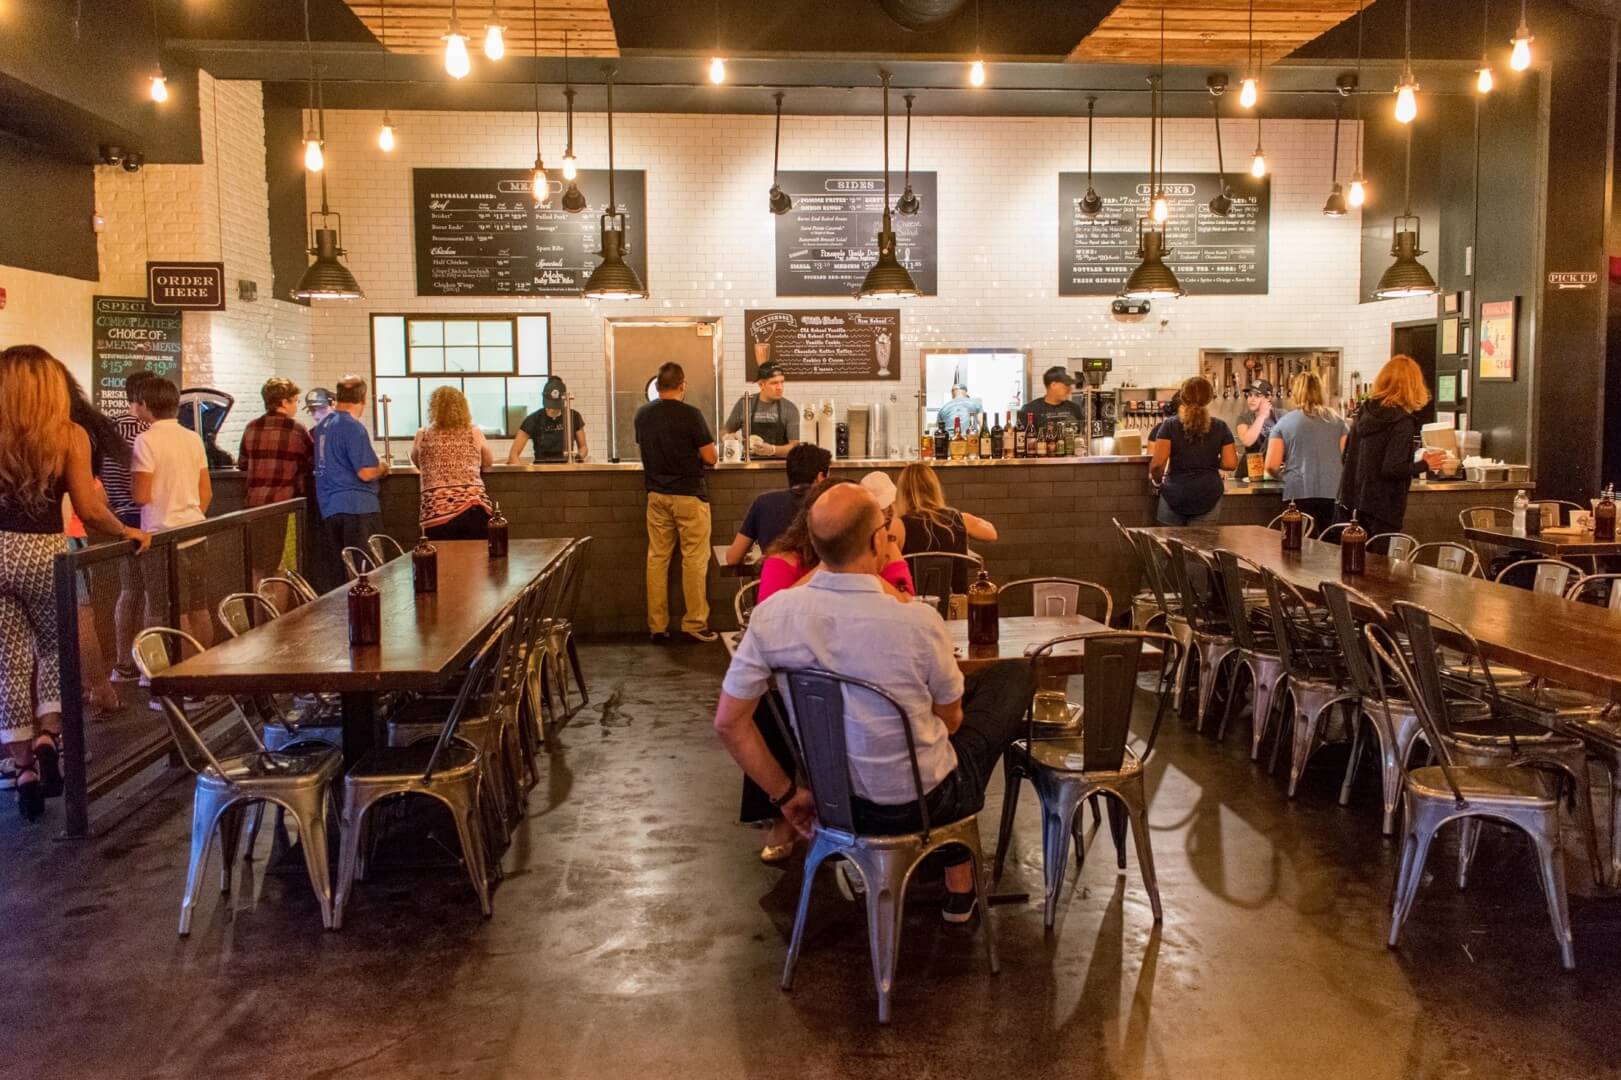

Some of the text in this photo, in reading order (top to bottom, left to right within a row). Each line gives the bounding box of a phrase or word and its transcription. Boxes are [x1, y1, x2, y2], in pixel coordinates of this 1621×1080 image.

[837, 181, 875, 189] SIDES
[156, 276, 214, 286] ORDER
[1551, 274, 1595, 282] PICK UP
[164, 287, 209, 297] HERE
[102, 303, 146, 312] SPECI
[107, 328, 168, 340] CHOICE OF:
[101, 390, 128, 399] BRISK
